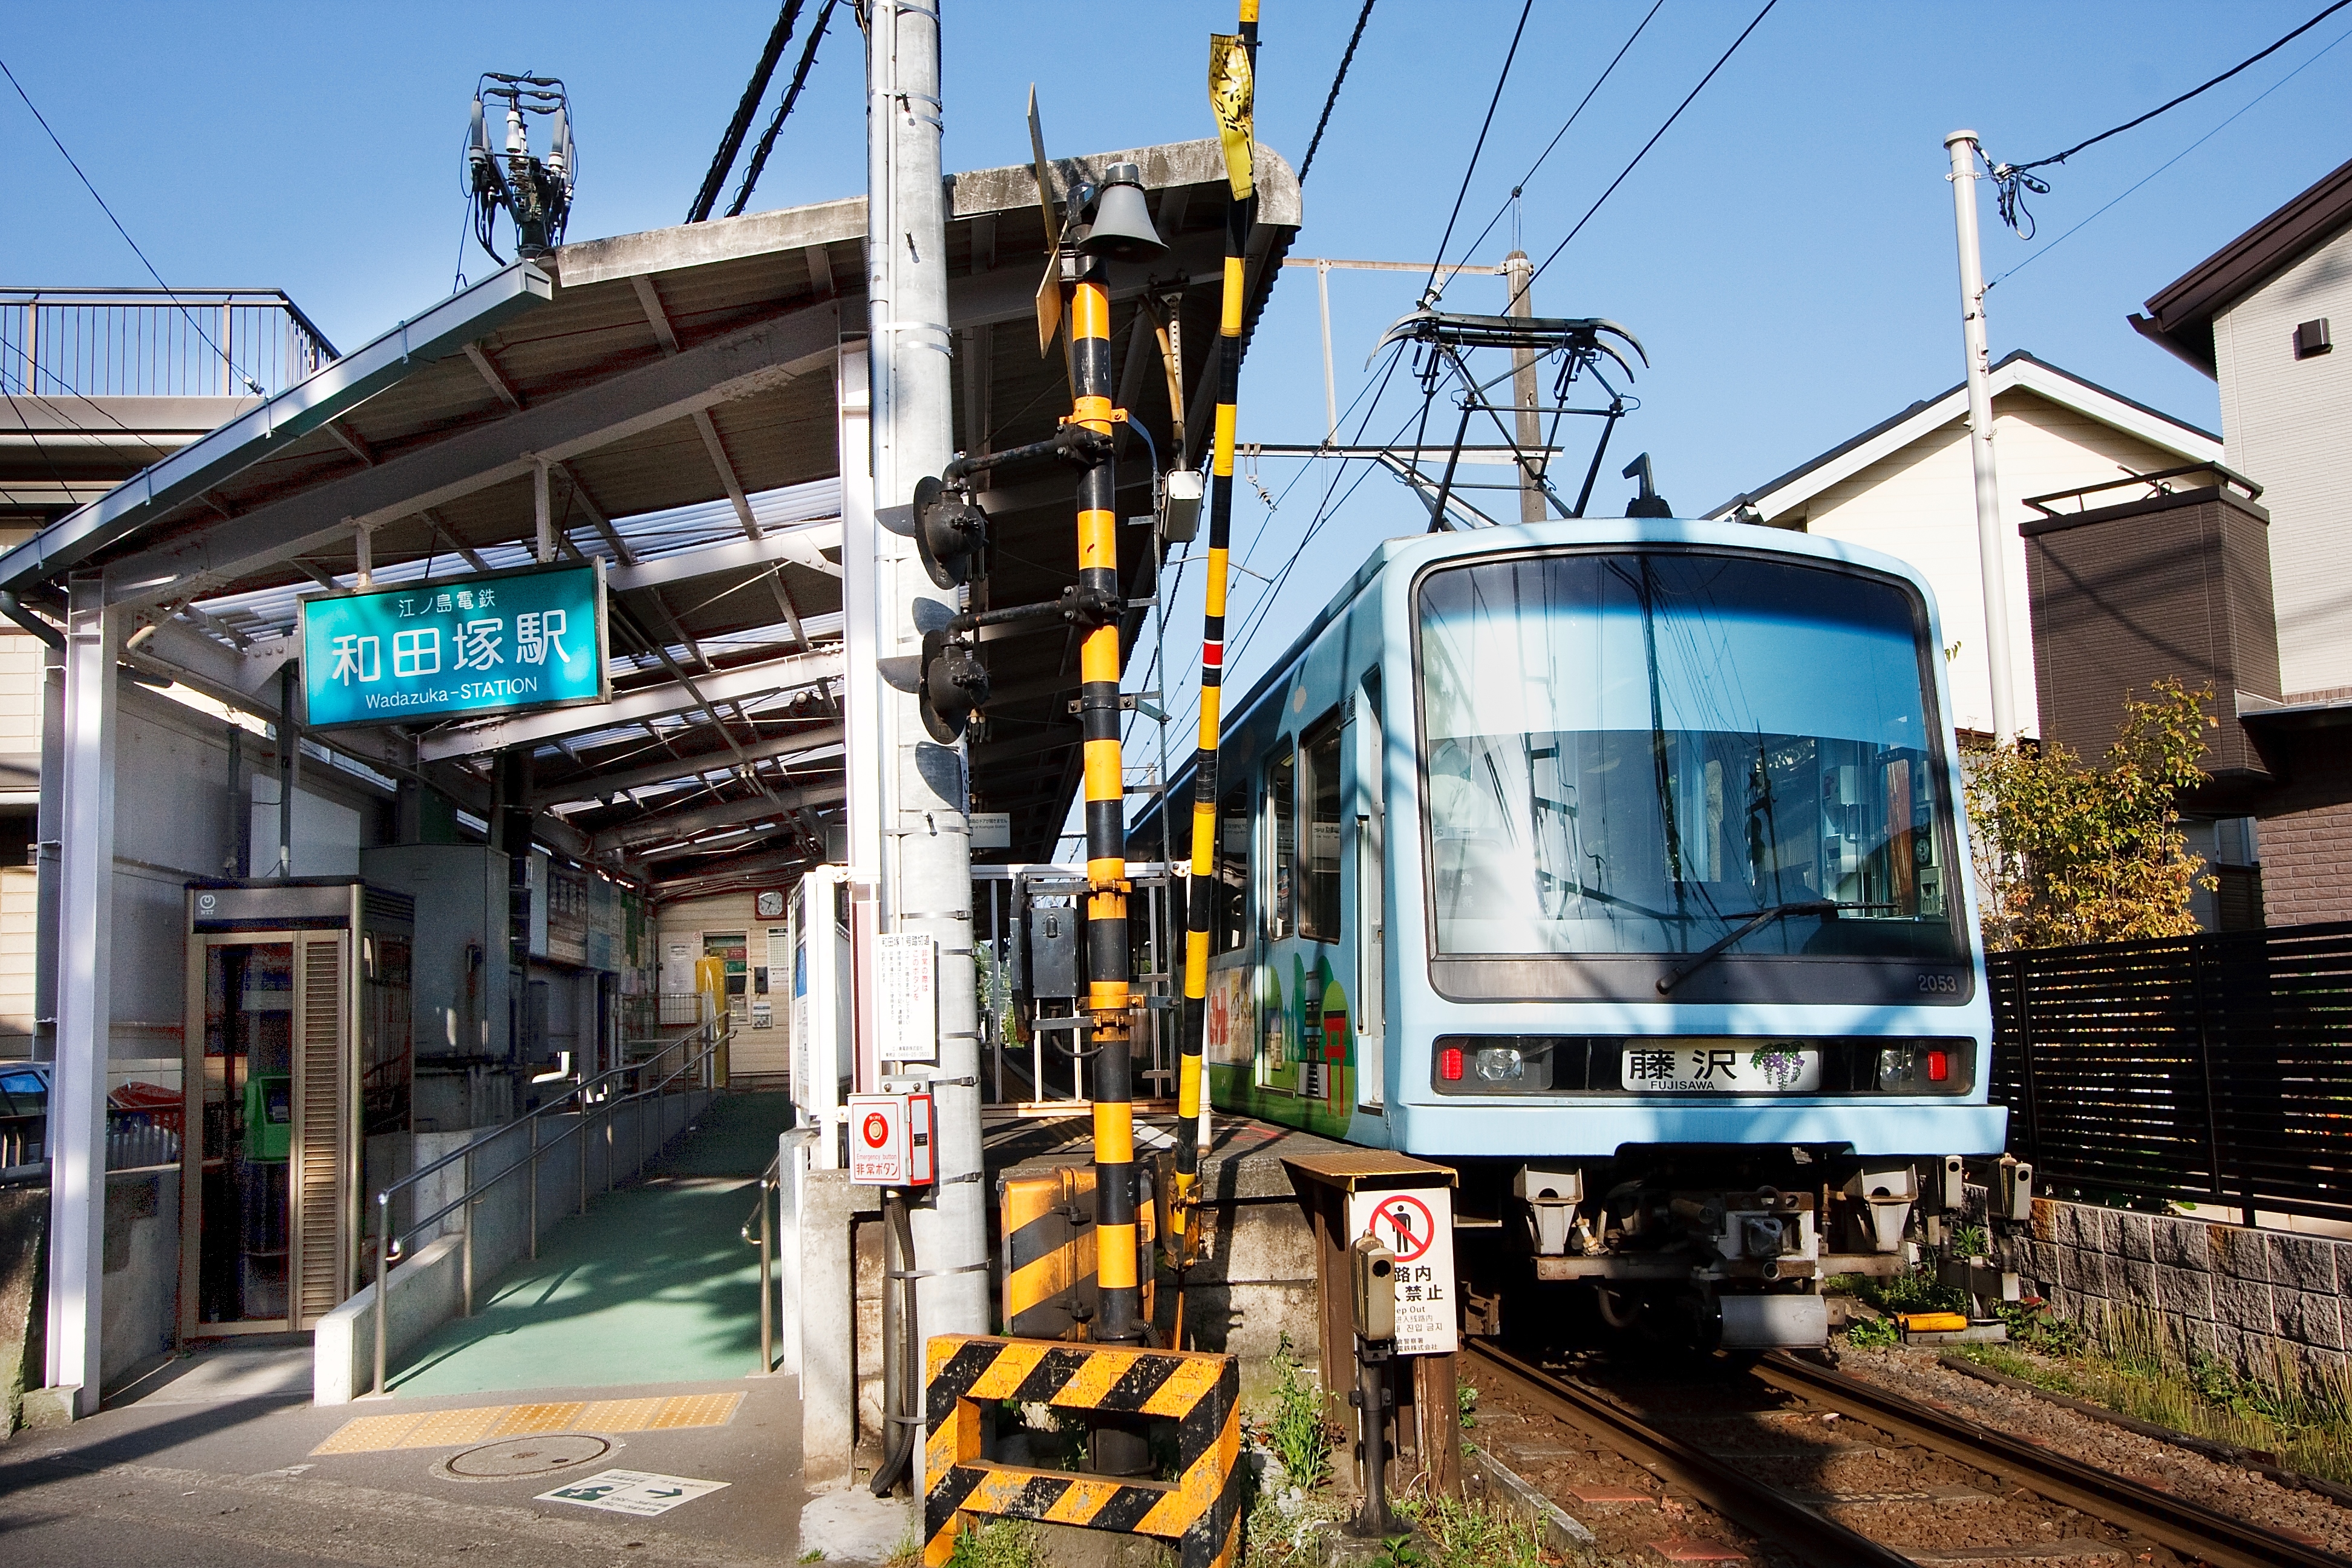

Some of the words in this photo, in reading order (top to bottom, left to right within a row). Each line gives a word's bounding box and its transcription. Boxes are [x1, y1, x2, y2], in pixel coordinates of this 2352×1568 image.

[399, 589, 495, 618] 江ノ島電鉄
[332, 609, 570, 686] 和田塚駅
[365, 677, 538, 709] Wadazuka-STATION
[1918, 975, 1956, 992] 2053
[1629, 1049, 1737, 1080] 藤沢
[1650, 1080, 1715, 1089] FUJISAWA
[856, 1163, 898, 1176] 非常ボタン
[1406, 1324, 1422, 1333] 진입
[1426, 1322, 1442, 1331] 금지
